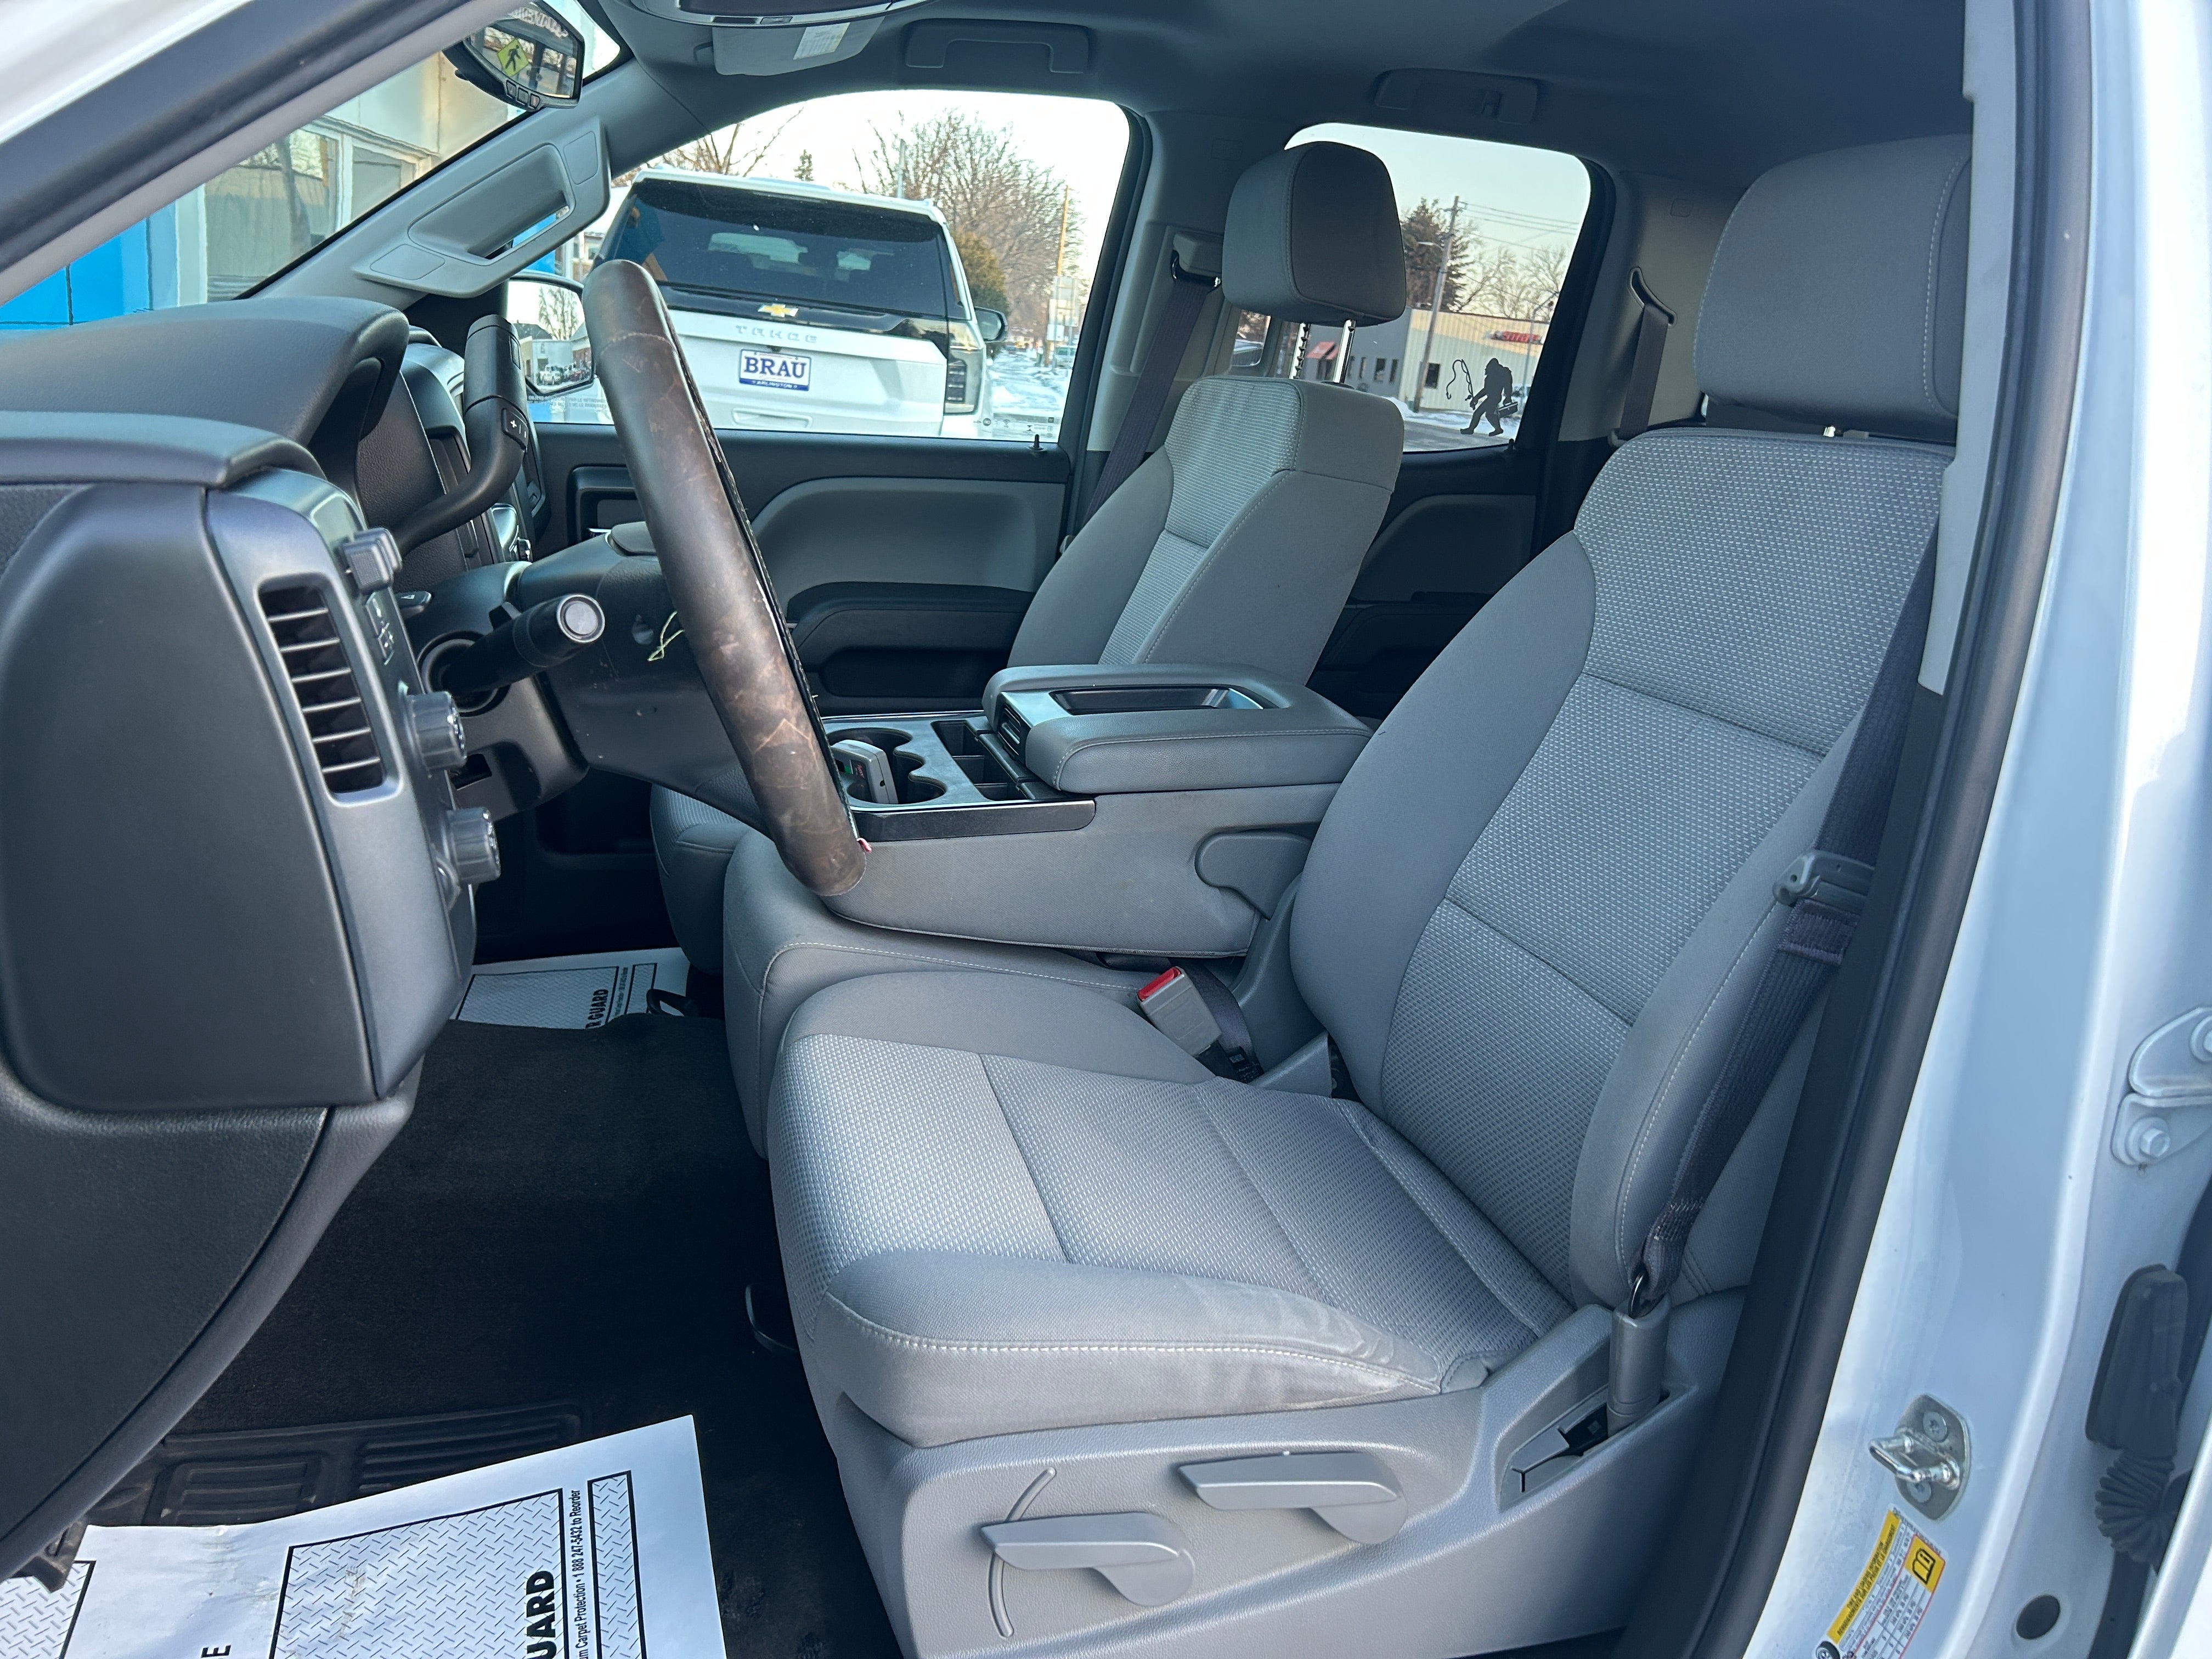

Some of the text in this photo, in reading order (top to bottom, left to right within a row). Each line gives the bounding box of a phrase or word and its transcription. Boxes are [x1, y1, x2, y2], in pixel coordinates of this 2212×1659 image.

[744, 356, 807, 379] BRAU
[588, 989, 608, 1020] GUARD
[569, 1490, 582, 1517] Reorder
[571, 1526, 584, 1557] 247-5432
[572, 1558, 584, 1572] 888
[573, 1583, 587, 1622] Protection
[575, 1622, 591, 1649] Carpet
